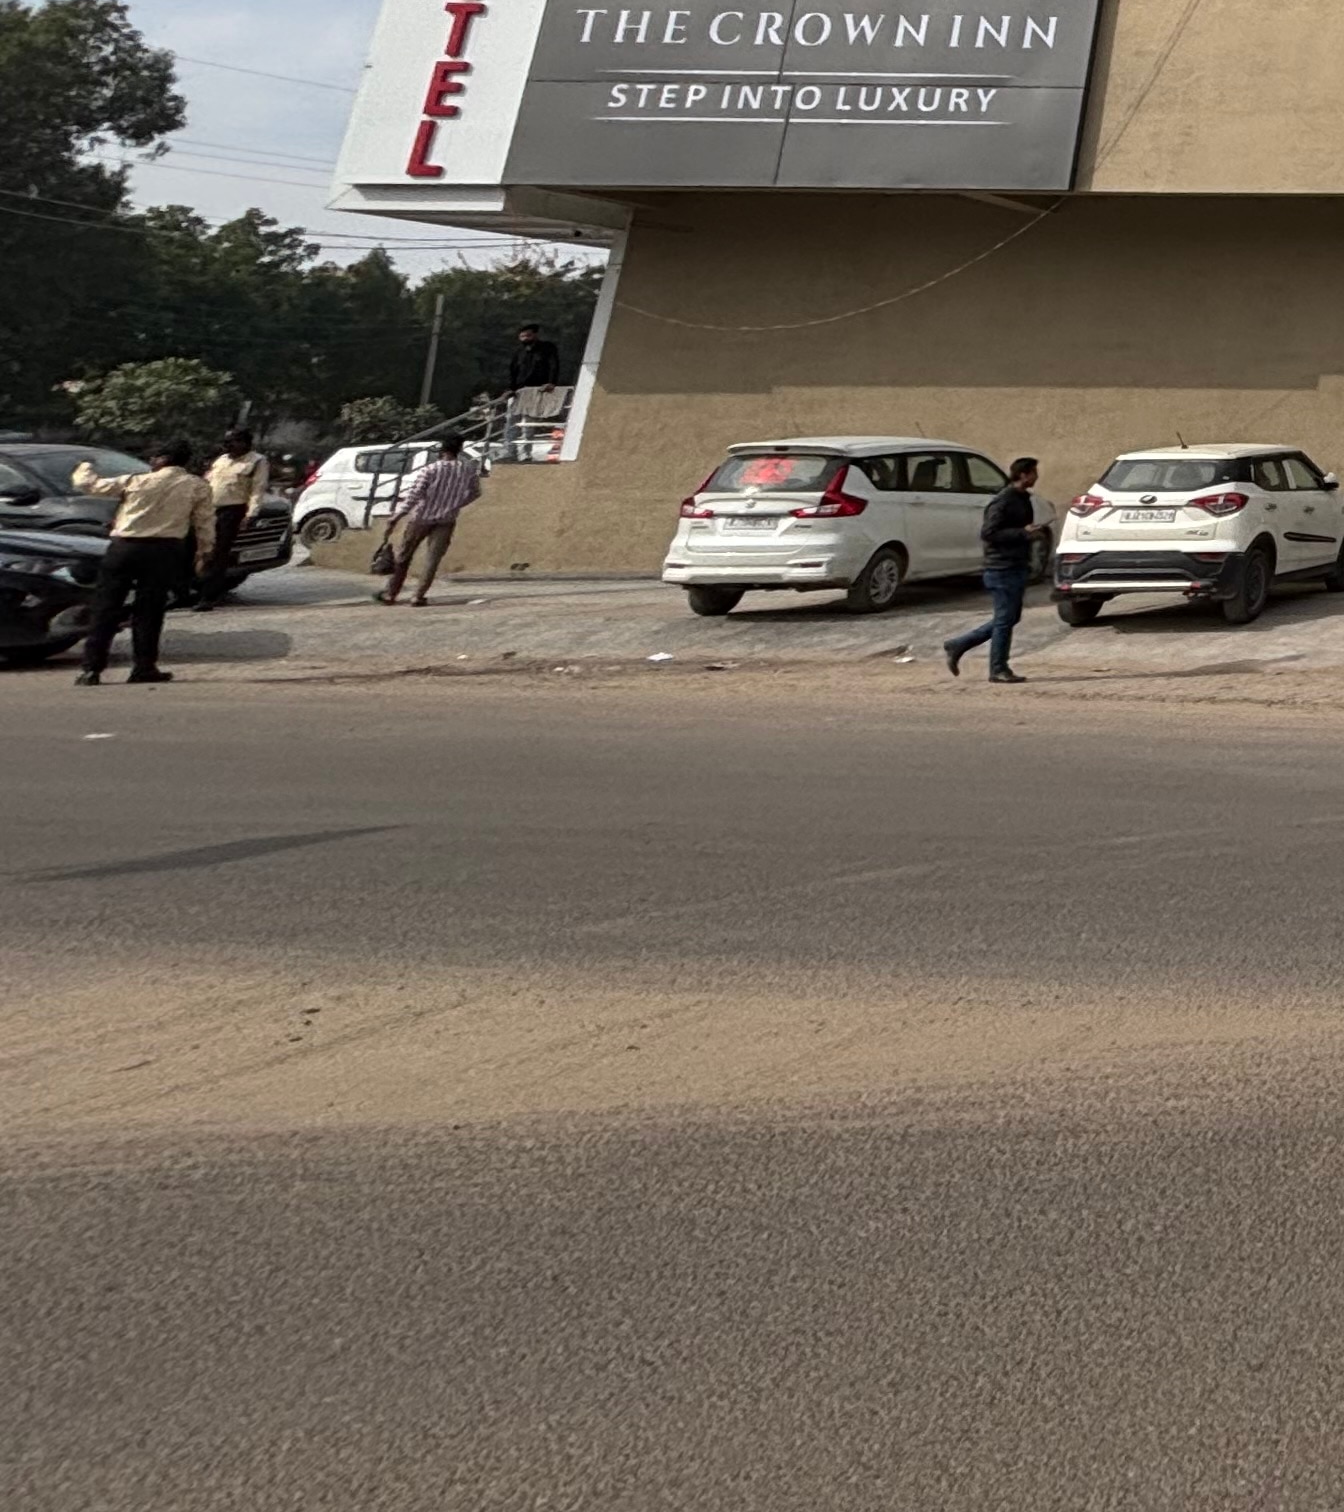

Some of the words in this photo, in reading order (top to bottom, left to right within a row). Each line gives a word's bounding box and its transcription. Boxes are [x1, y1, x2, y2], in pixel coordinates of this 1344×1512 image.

[575, 8, 691, 46] THE
[708, 10, 933, 49] CROWN
[949, 15, 1059, 51] INN
[607, 83, 708, 110] STEP
[719, 84, 821, 112] INTO
[835, 86, 998, 113] LUXURY
